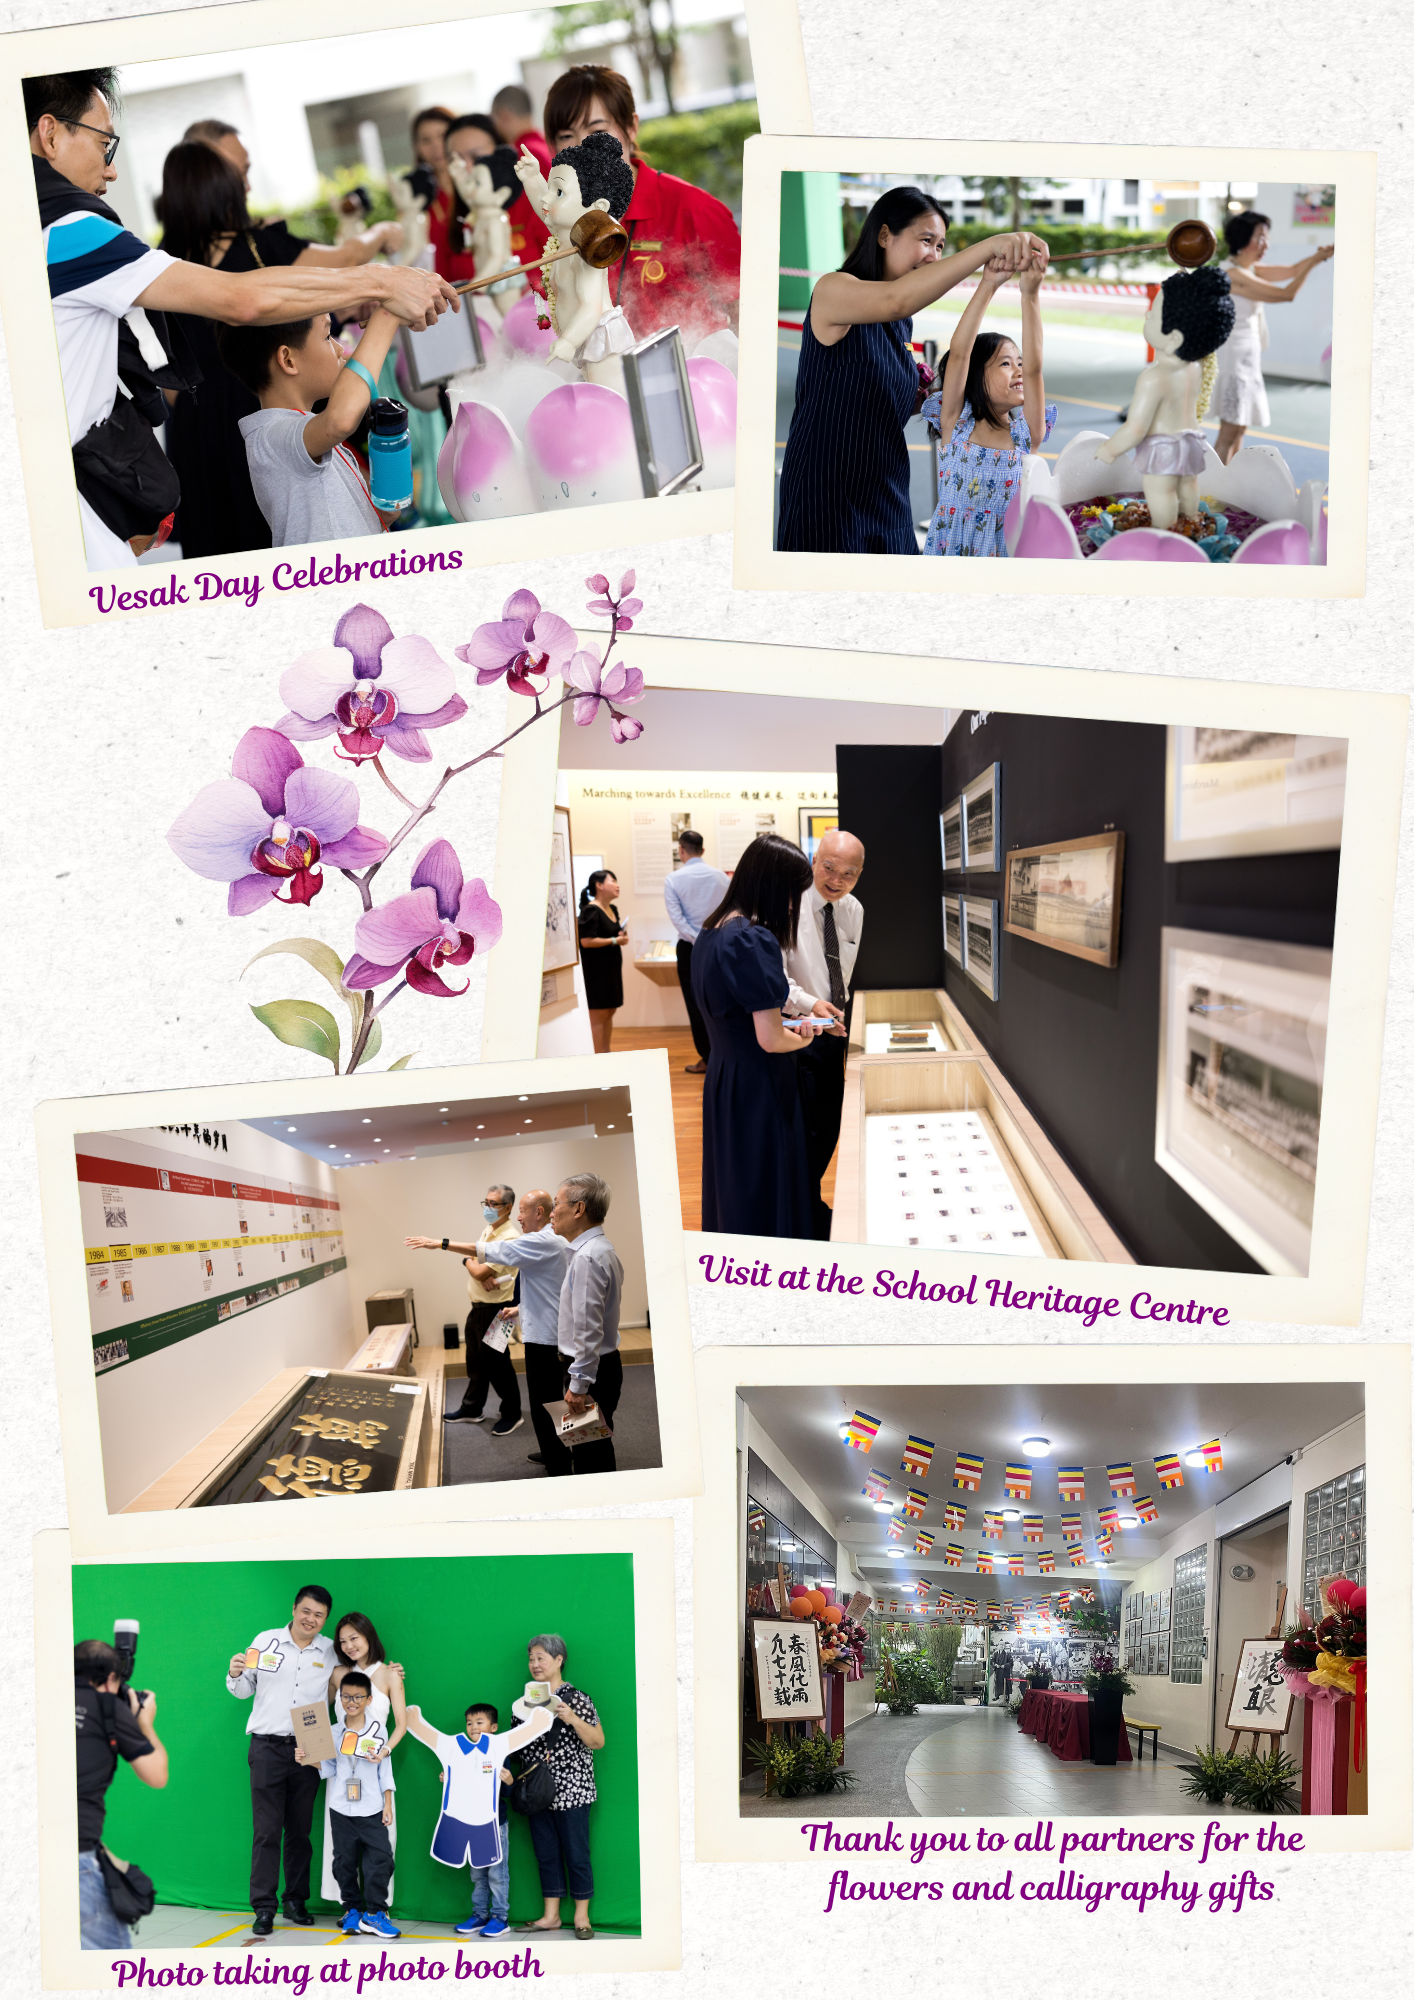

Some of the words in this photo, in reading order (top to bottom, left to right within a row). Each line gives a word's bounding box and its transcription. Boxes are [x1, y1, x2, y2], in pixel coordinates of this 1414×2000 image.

[582, 787, 632, 800] Marching
[635, 788, 676, 799] towards
[679, 788, 732, 799] Excellence
[88, 1250, 105, 1260] 1984
[113, 1248, 128, 1258] 1985
[134, 1246, 148, 1256] 1986
[153, 1245, 165, 1254] 1987
[170, 1244, 181, 1252] 1988
[184, 1243, 195, 1251] 1989
